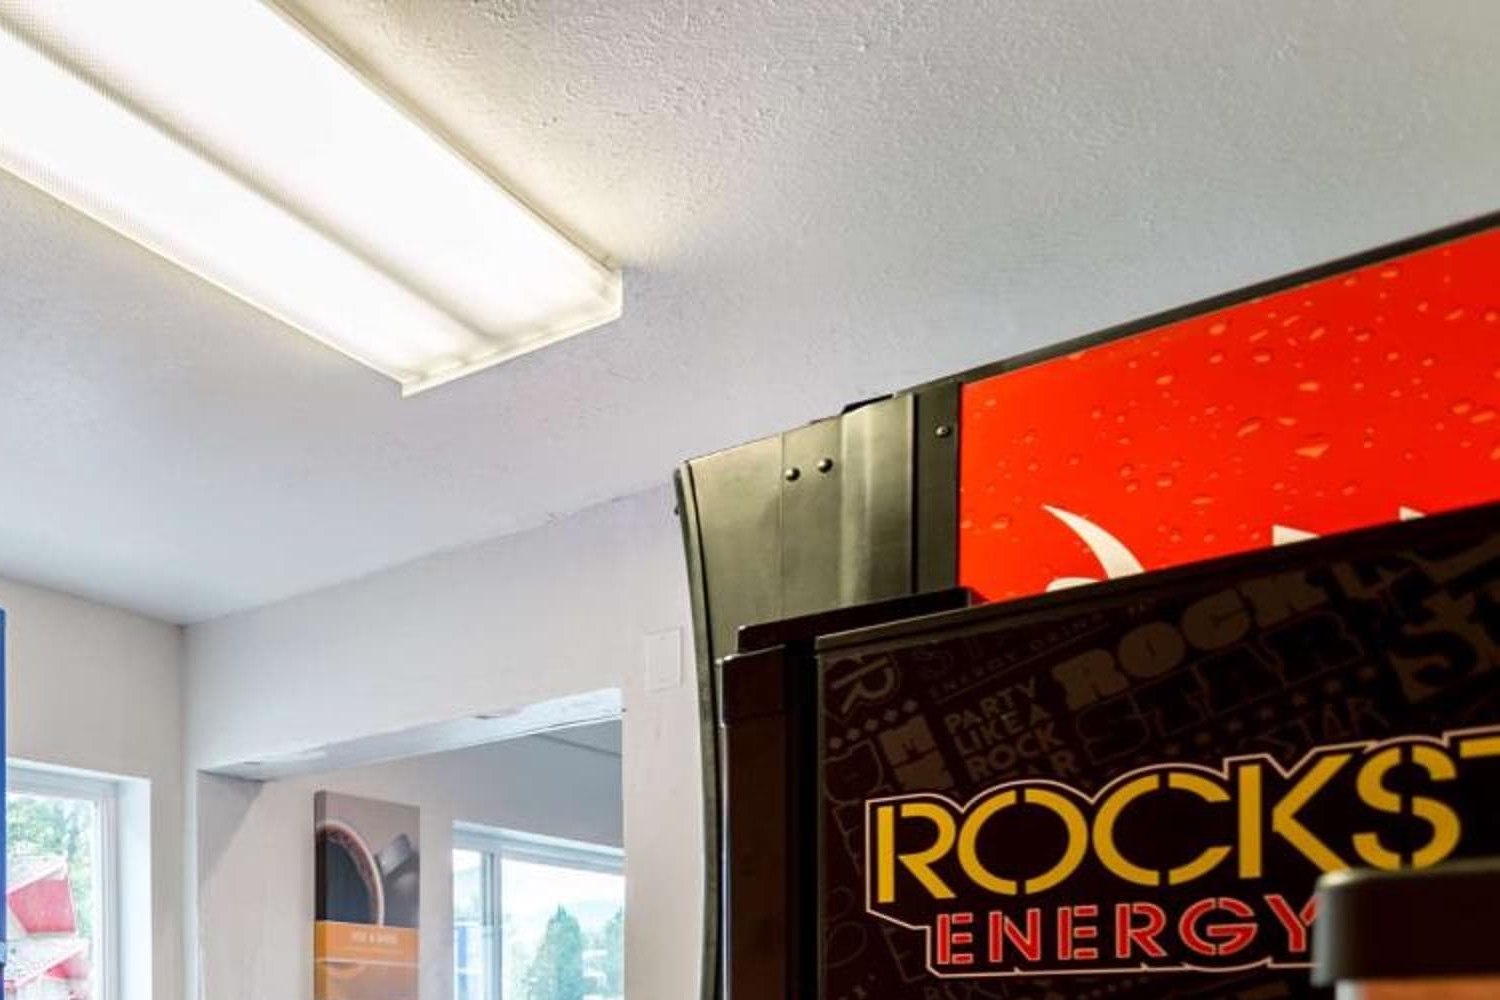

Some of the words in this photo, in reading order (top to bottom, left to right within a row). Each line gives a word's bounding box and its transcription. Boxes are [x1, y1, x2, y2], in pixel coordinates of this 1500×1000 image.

[942, 674, 1038, 736] PARTY
[952, 707, 1028, 759] LIKE
[1028, 702, 1053, 728] A
[965, 720, 1067, 783] ROCK
[936, 894, 1321, 967] ENERGY
